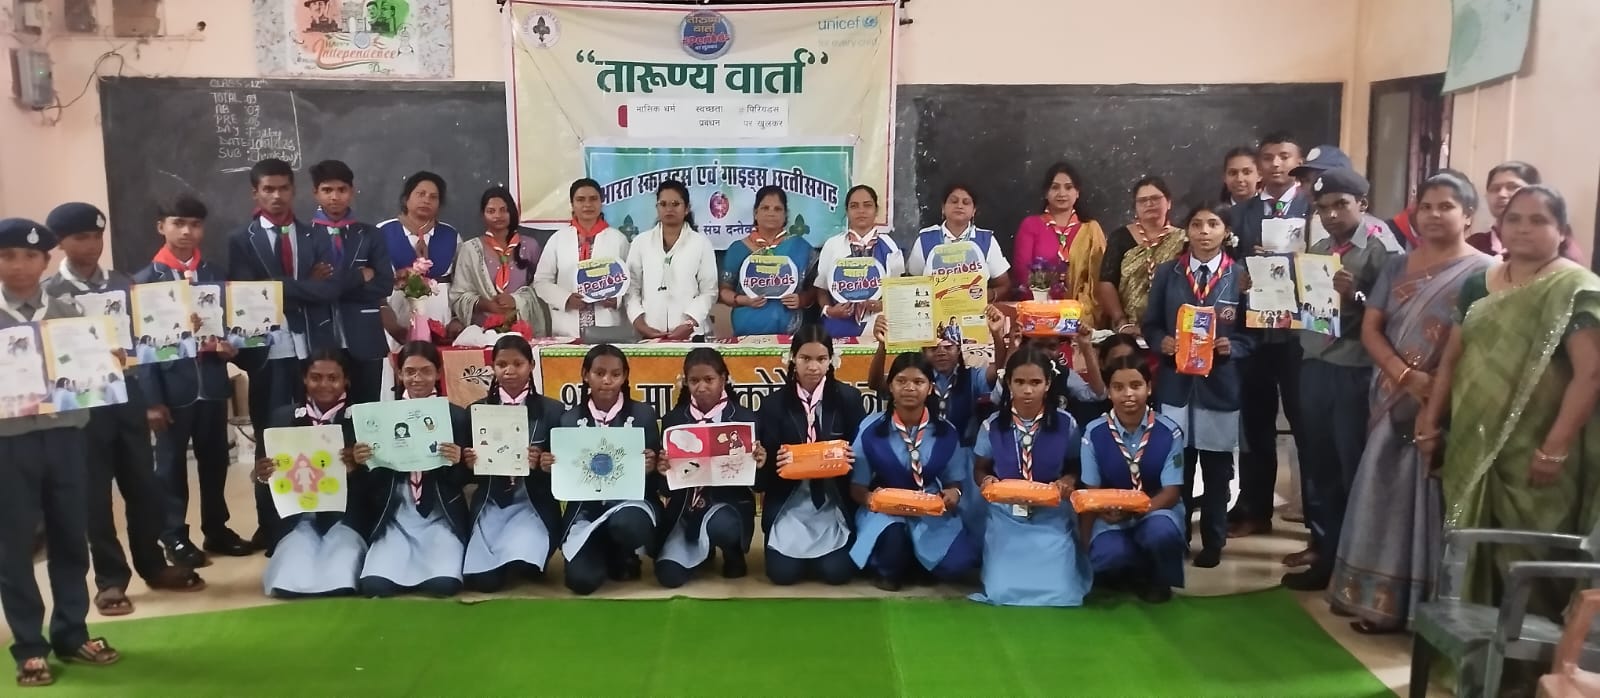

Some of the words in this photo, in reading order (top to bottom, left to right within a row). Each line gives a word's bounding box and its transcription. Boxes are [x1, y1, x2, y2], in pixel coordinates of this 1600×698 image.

[818, 16, 860, 30] unicef
[313, 39, 397, 63] Independence
[209, 92, 242, 103] TOTAL
[218, 147, 241, 158] SUB
[600, 177, 635, 205] भारत
[696, 160, 718, 186] एवं
[703, 220, 721, 236] संघ
[578, 272, 628, 294] #Periods
[743, 273, 796, 288] #Periods
